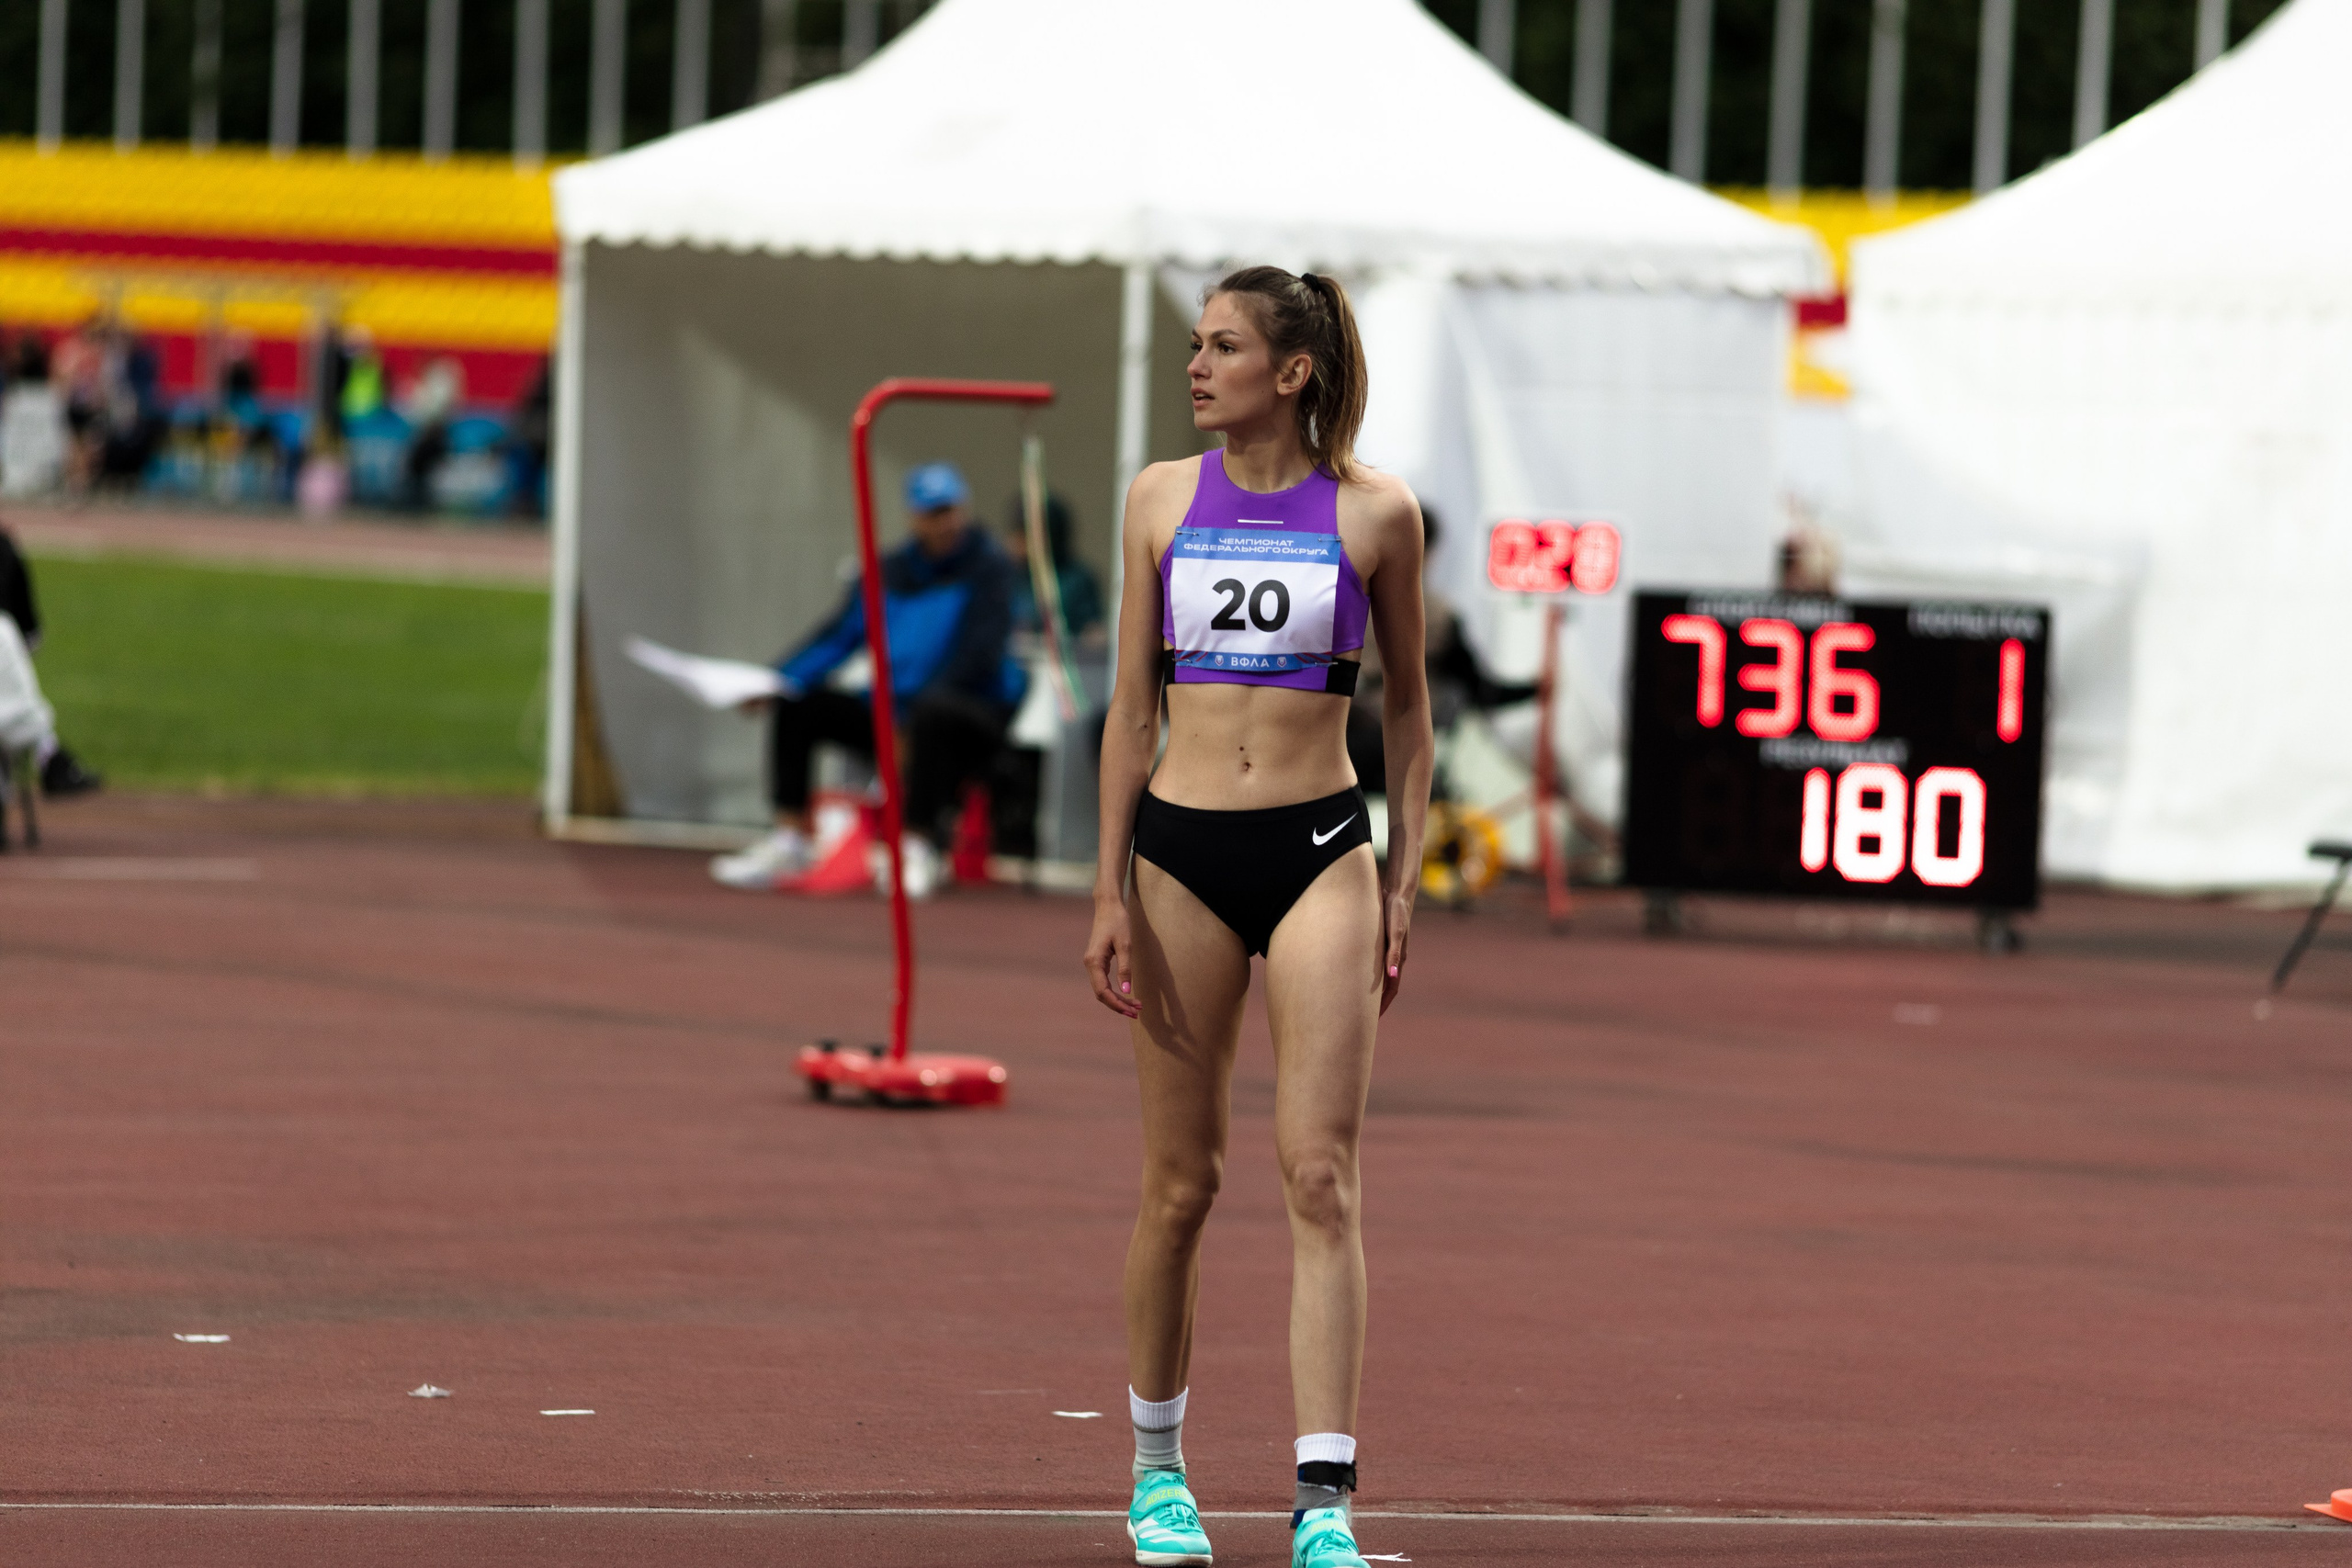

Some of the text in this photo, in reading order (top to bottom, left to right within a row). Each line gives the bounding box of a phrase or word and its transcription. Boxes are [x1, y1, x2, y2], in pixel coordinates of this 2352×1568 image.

[1218, 537, 1295, 547] ЧЕМПИОНАТ
[1211, 578, 1290, 632] 20
[1231, 657, 1270, 668] ВФЛА
[1661, 615, 1880, 742] 736
[1997, 637, 2025, 743] 1
[1800, 762, 1986, 887] 180
